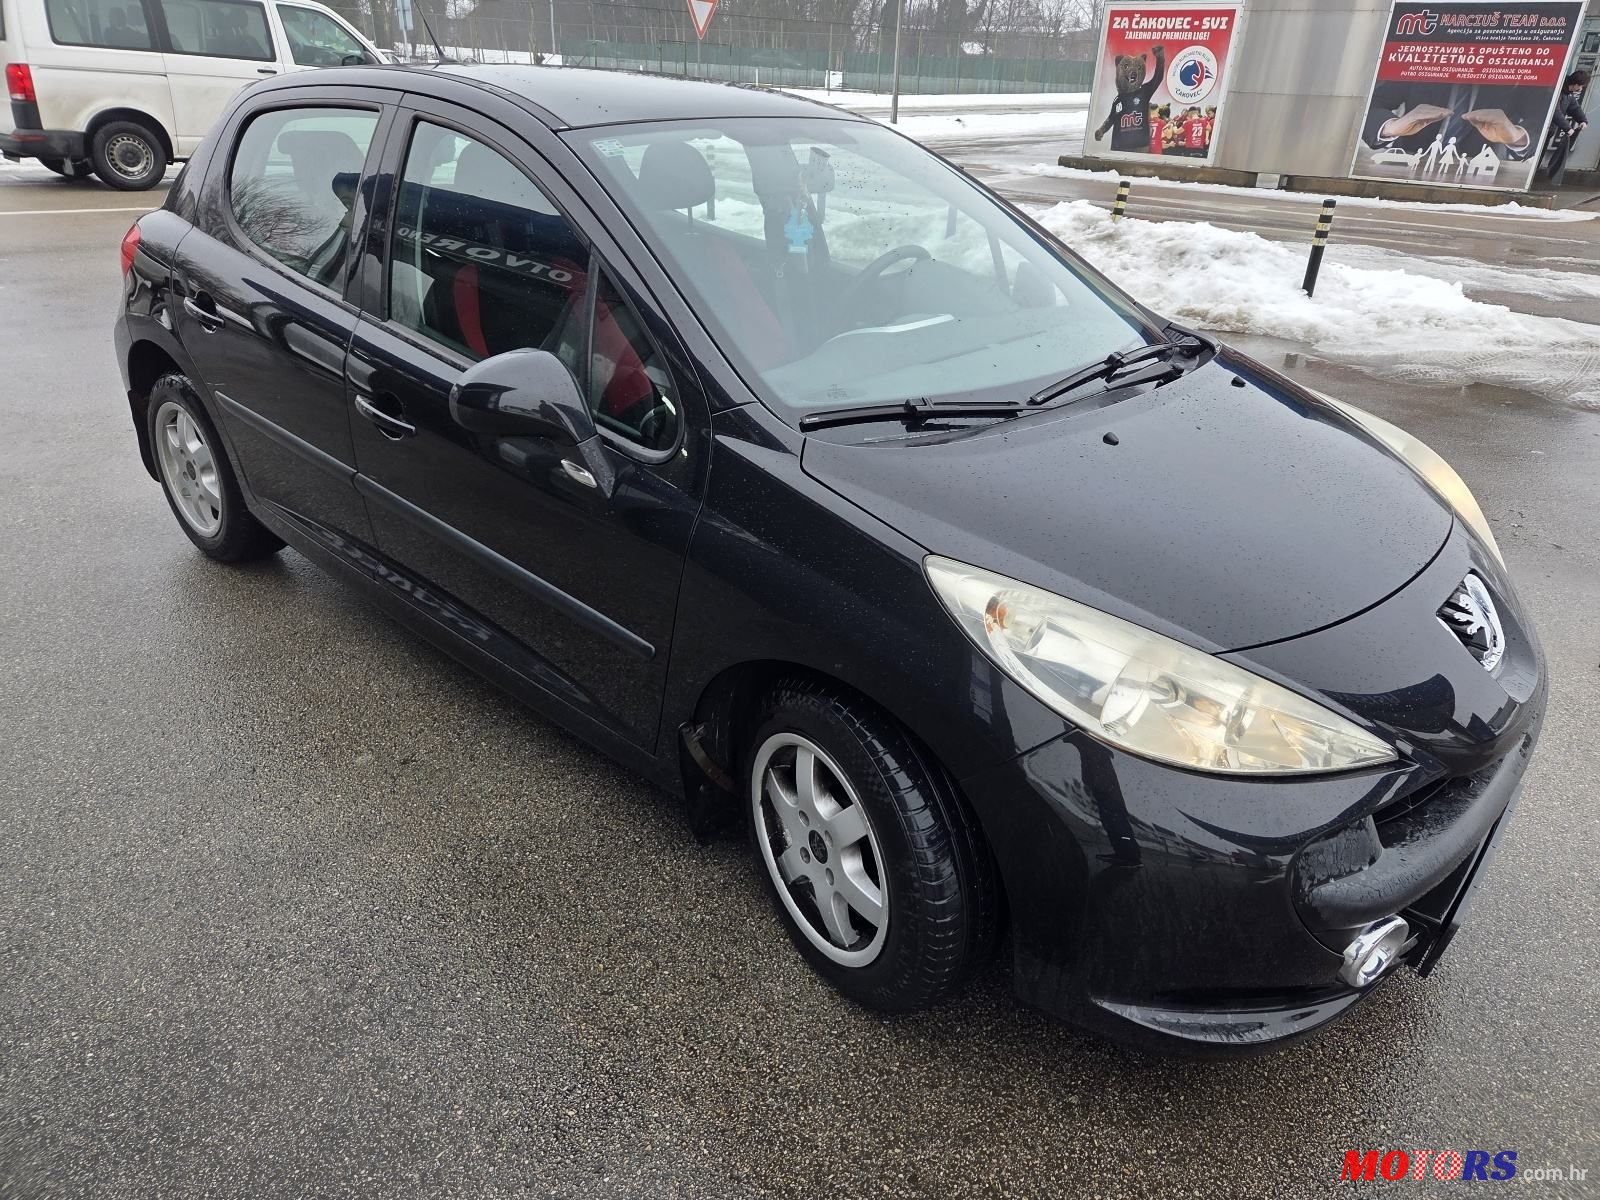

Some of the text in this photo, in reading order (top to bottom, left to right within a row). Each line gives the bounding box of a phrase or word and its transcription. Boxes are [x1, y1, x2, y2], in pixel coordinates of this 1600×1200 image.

[1112, 16, 1129, 29] ZA
[1131, 13, 1192, 30] ČAKOVEC
[1201, 16, 1229, 30] SVI
[1440, 11, 1501, 27] MARCIUŠ
[1503, 14, 1539, 27] TEAM
[1125, 31, 1151, 40] ZAJEDNO
[1152, 31, 1161, 40] DO
[1161, 31, 1192, 40] PREMIJER
[1529, 28, 1565, 36] osiguranju
[1397, 45, 1465, 54] JEDNOSTAVNO
[1479, 46, 1532, 55] OPUŠTENO
[1536, 48, 1550, 56] DO
[1388, 53, 1554, 66] KVALITETNOG OSIGURANJA
[1191, 126, 1203, 137] 23
